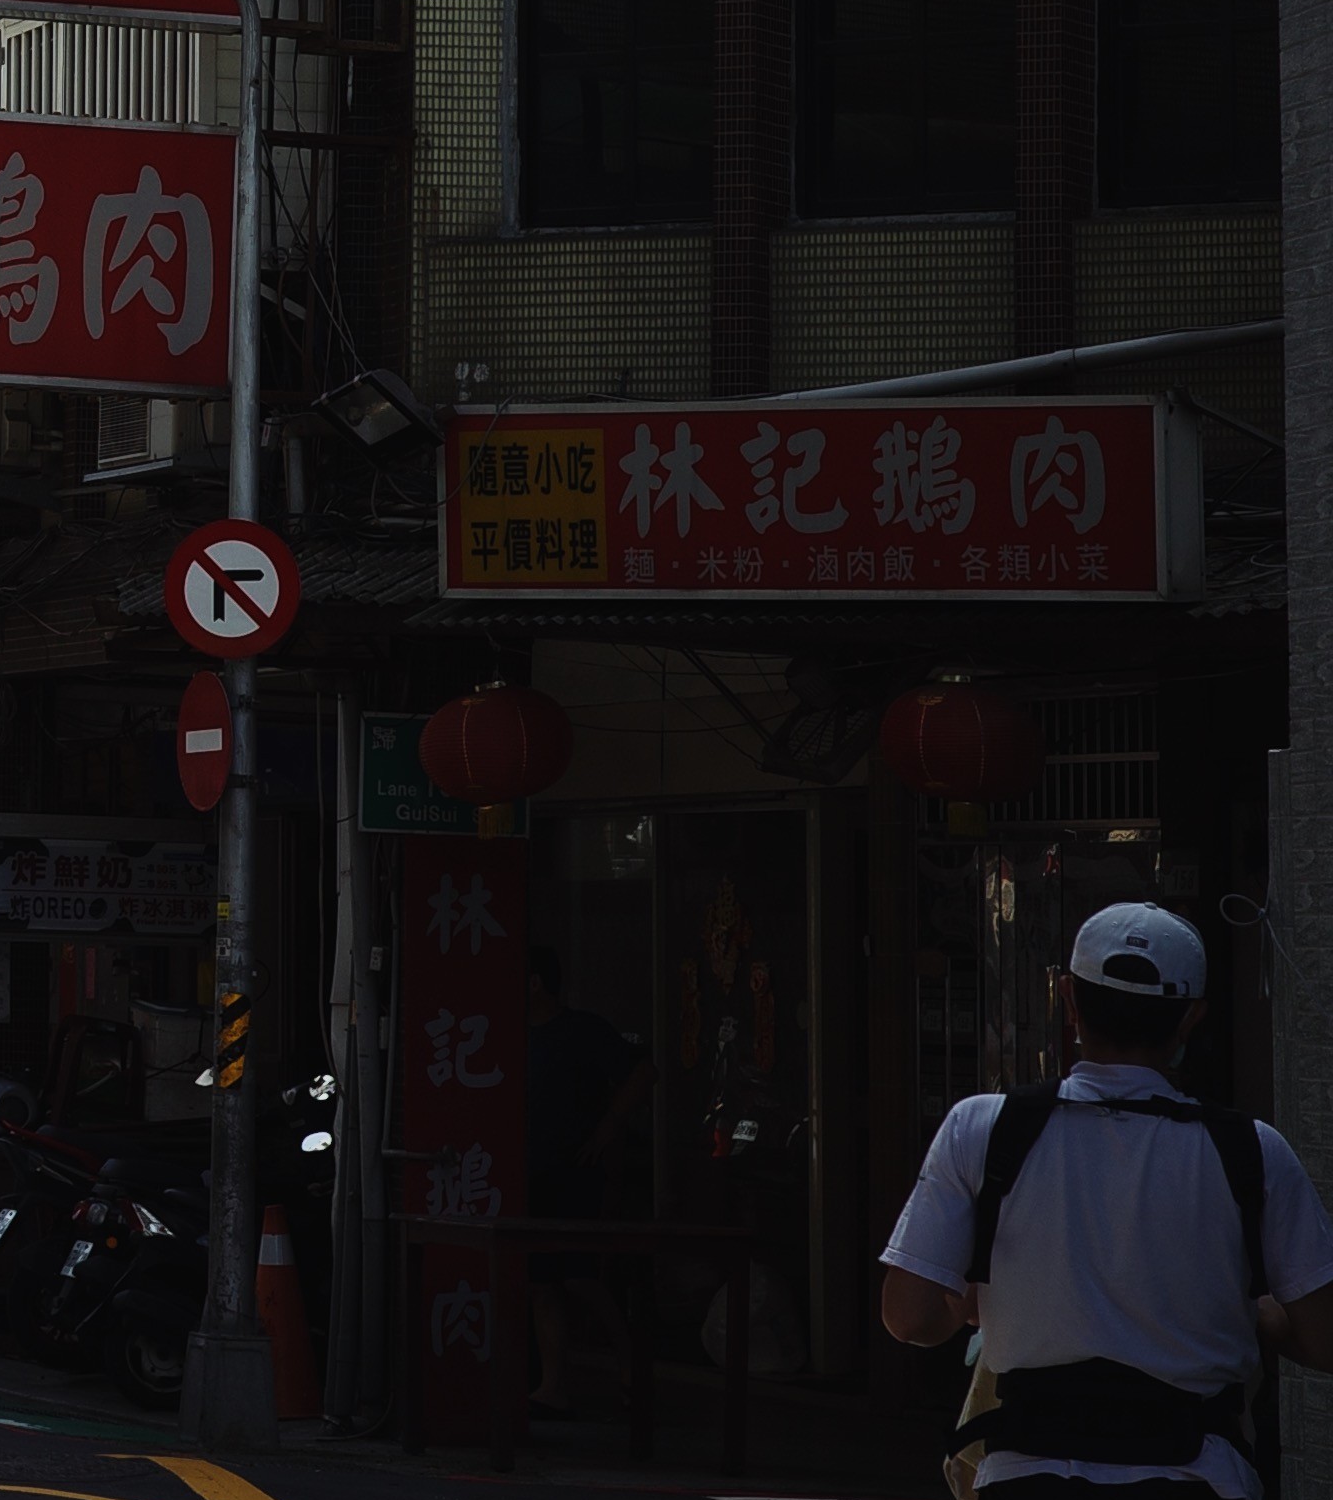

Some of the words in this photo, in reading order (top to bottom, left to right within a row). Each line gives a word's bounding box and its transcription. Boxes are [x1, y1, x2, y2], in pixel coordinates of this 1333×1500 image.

[468, 442, 597, 498] 隨意小吃
[618, 414, 1106, 538] 林記鵝肉
[470, 518, 600, 571] 平價料理
[377, 779, 417, 797] Lane
[11, 851, 132, 889] 炸鮮奶
[118, 896, 211, 919] 炸冰淇淋
[424, 872, 509, 1365] 林記鵝肉
